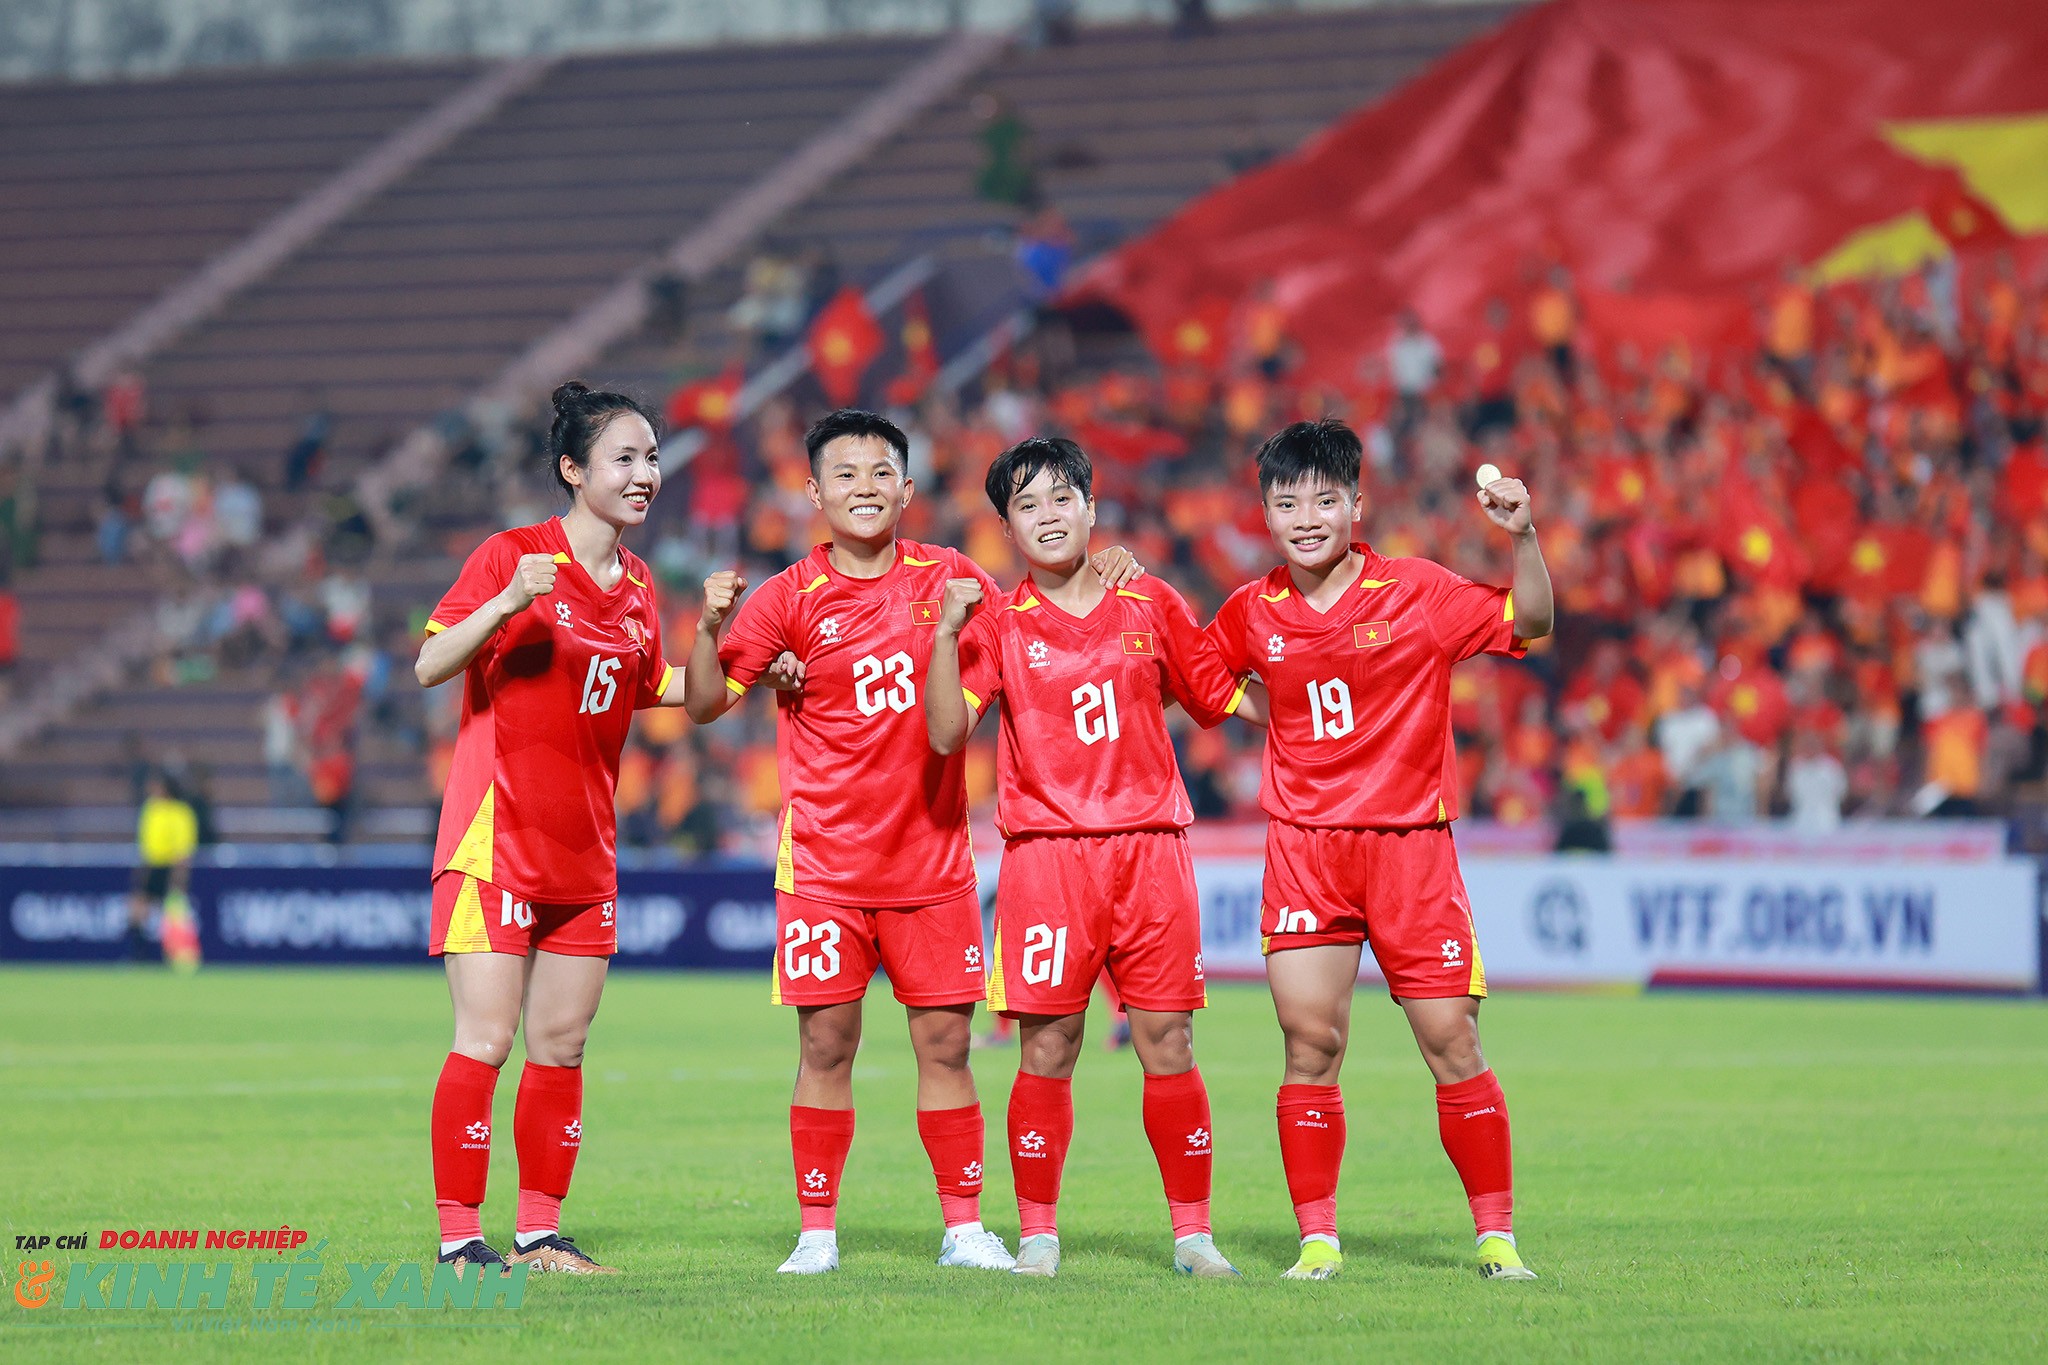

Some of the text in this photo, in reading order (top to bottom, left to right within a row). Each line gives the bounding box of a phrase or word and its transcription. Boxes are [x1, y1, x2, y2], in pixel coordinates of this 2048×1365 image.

[578, 653, 623, 716] 15
[852, 650, 917, 718] 23
[1071, 678, 1121, 747] 21
[1306, 676, 1355, 743] 19
[784, 917, 841, 983] 23
[1021, 921, 1068, 989] 21
